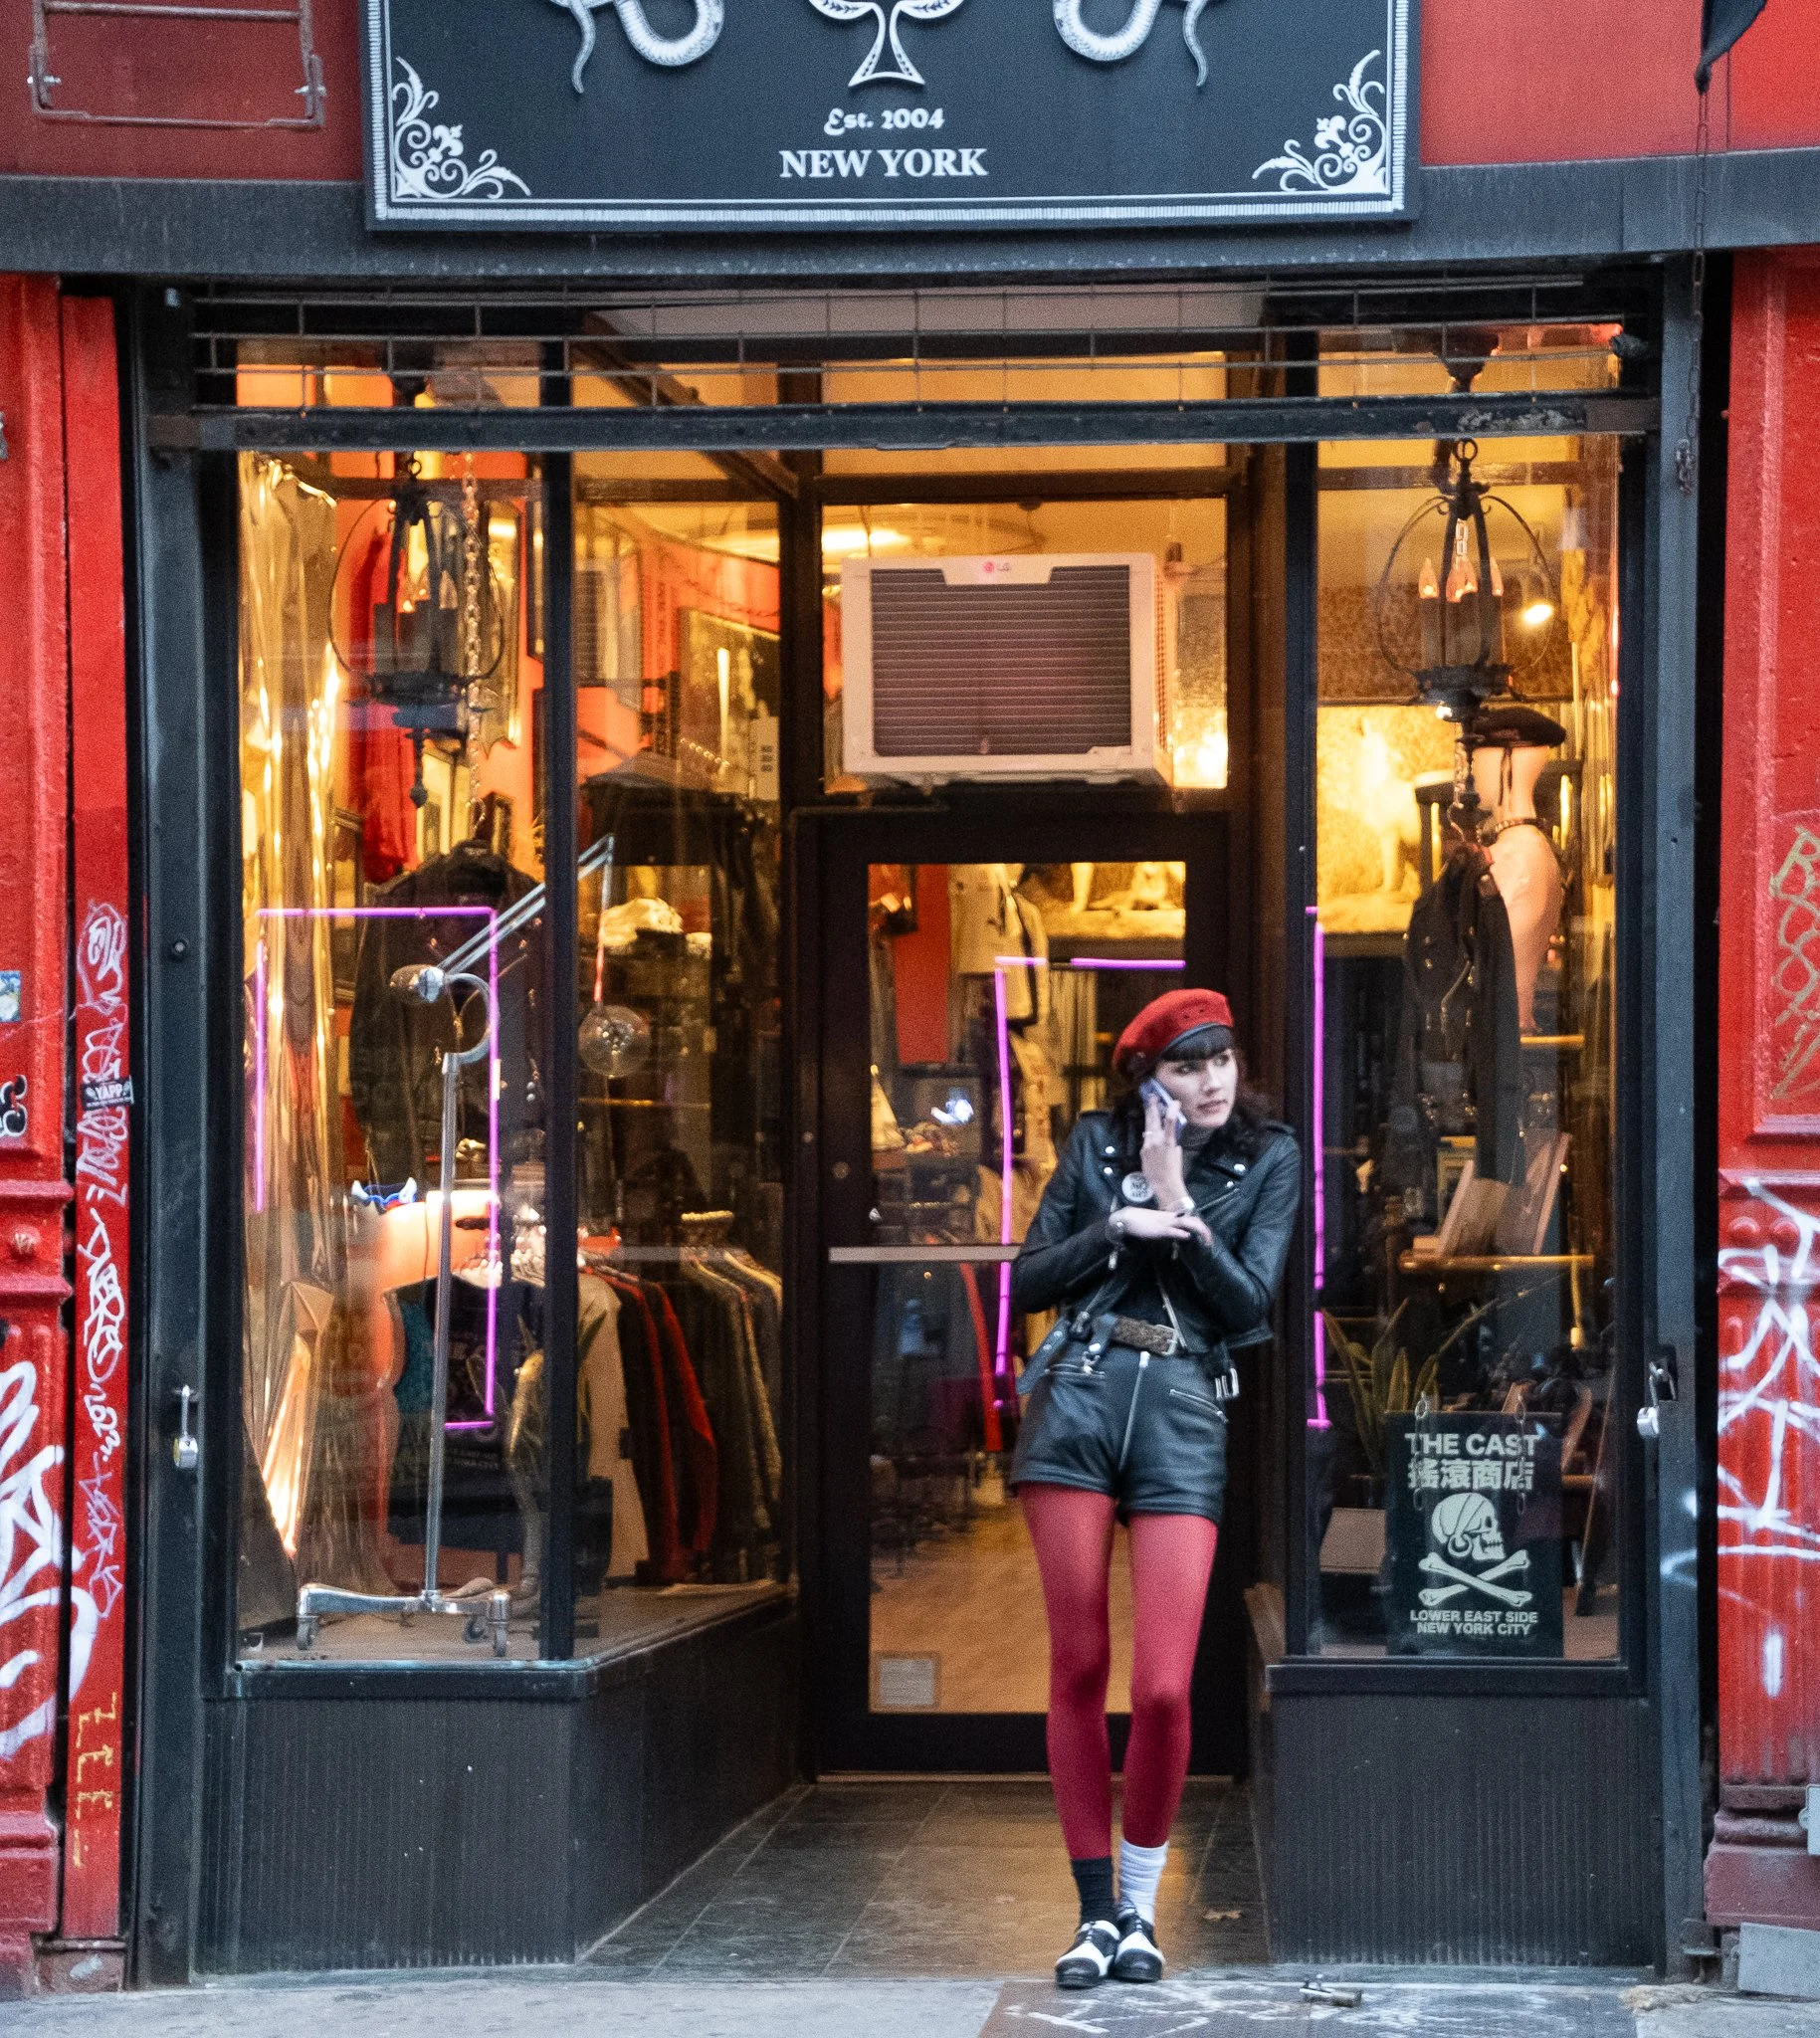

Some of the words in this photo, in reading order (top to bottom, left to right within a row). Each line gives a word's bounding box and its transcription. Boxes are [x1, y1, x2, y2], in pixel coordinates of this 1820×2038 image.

[824, 107, 874, 136] Est.
[882, 107, 944, 129] 2004
[779, 149, 872, 177] NEW
[878, 148, 988, 176] YORK
[1404, 1433, 1460, 1455] THE
[1465, 1433, 1540, 1456] CAST
[1410, 1609, 1461, 1622] LOWER
[1464, 1610, 1502, 1622] EAST
[1506, 1610, 1538, 1623] SIDE
[1417, 1622, 1450, 1634] NEW
[1454, 1622, 1495, 1634] YORK
[1498, 1623, 1531, 1635] CITY
